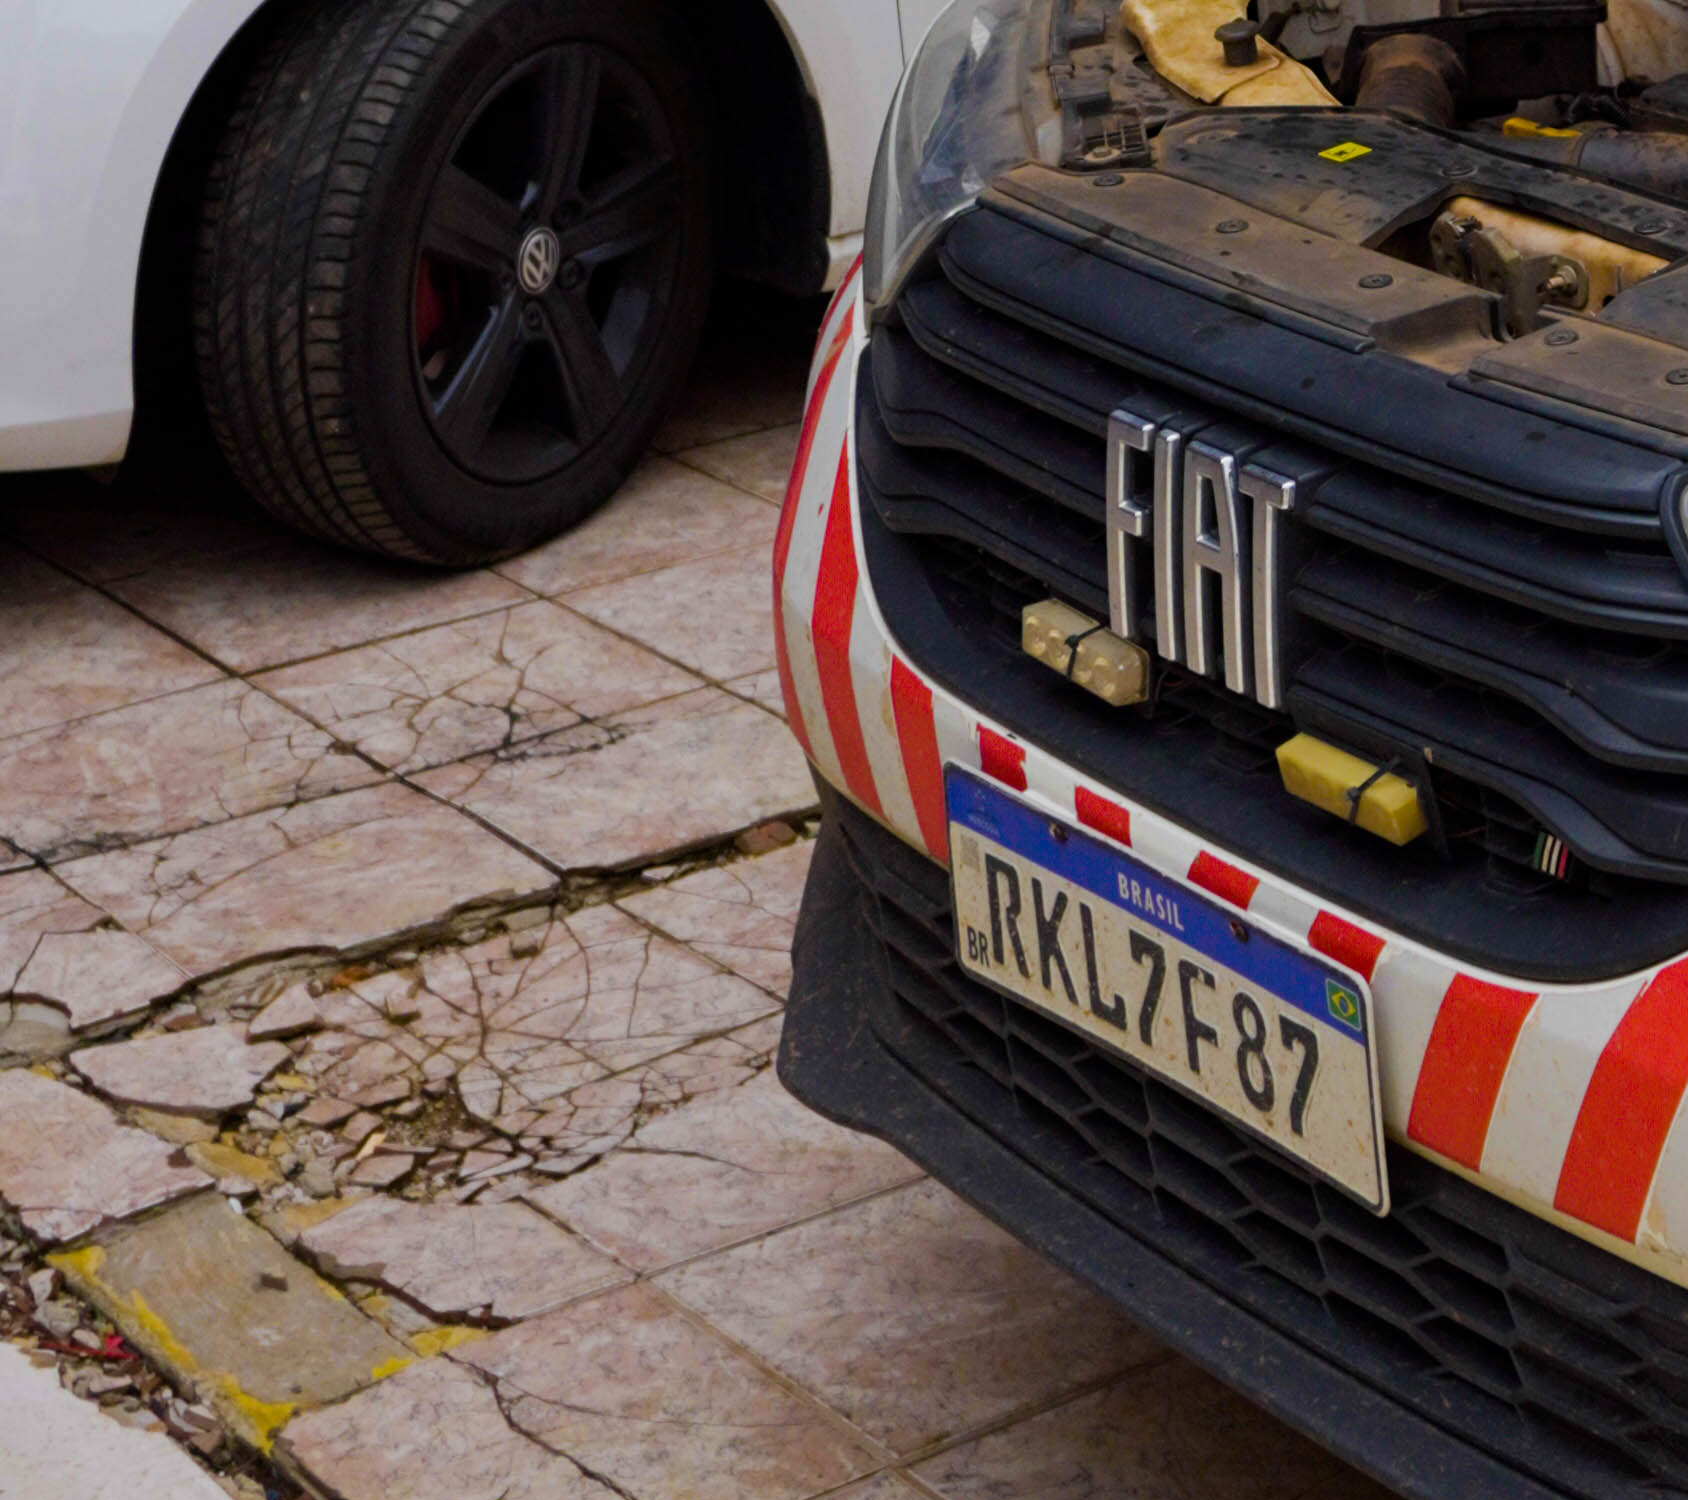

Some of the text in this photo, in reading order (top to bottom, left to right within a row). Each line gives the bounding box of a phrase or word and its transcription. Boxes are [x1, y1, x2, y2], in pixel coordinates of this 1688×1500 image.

[1106, 409, 1297, 710] FIAT
[967, 925, 990, 968] BR
[1117, 871, 1185, 931] BRASIL
[985, 853, 1319, 1138] RKL7F87
